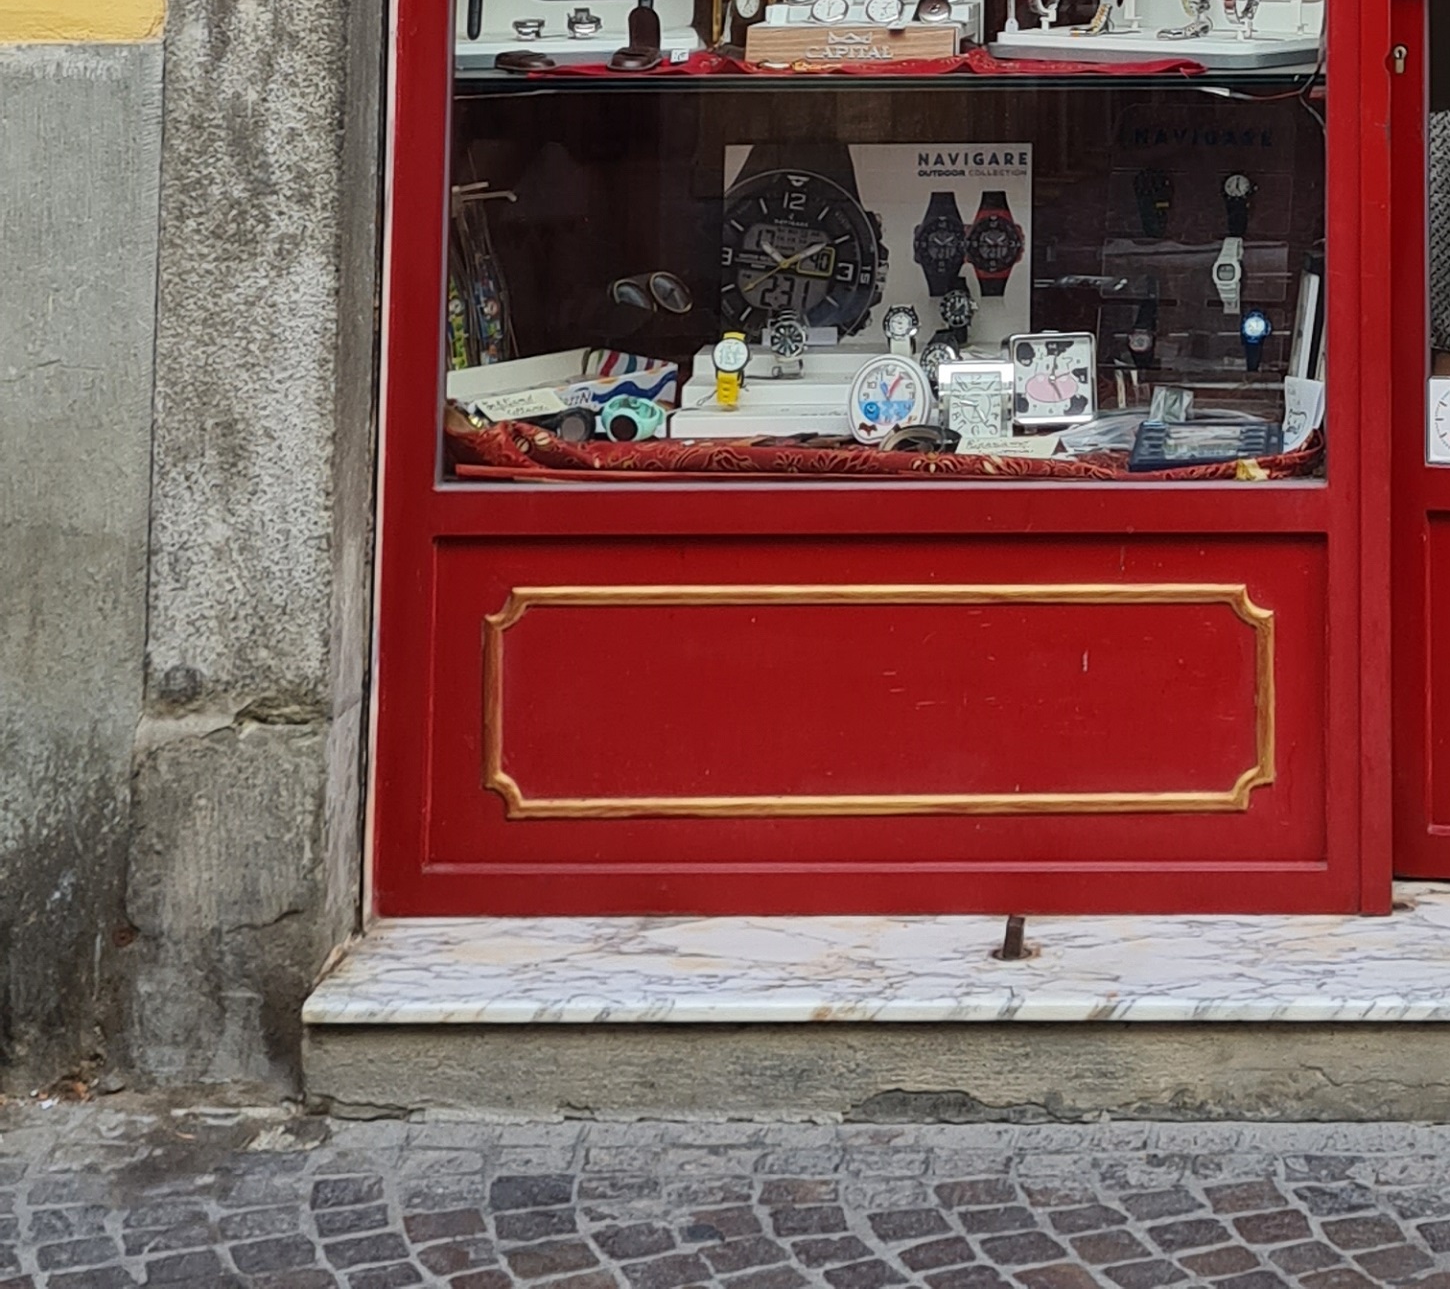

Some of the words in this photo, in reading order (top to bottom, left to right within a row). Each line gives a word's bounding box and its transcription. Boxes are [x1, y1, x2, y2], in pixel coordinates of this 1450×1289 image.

[805, 44, 892, 60] CAPITAL
[918, 152, 1028, 166] NAVIGARE
[918, 169, 966, 177] OUTDOOR
[968, 169, 1027, 177] COLLECTION
